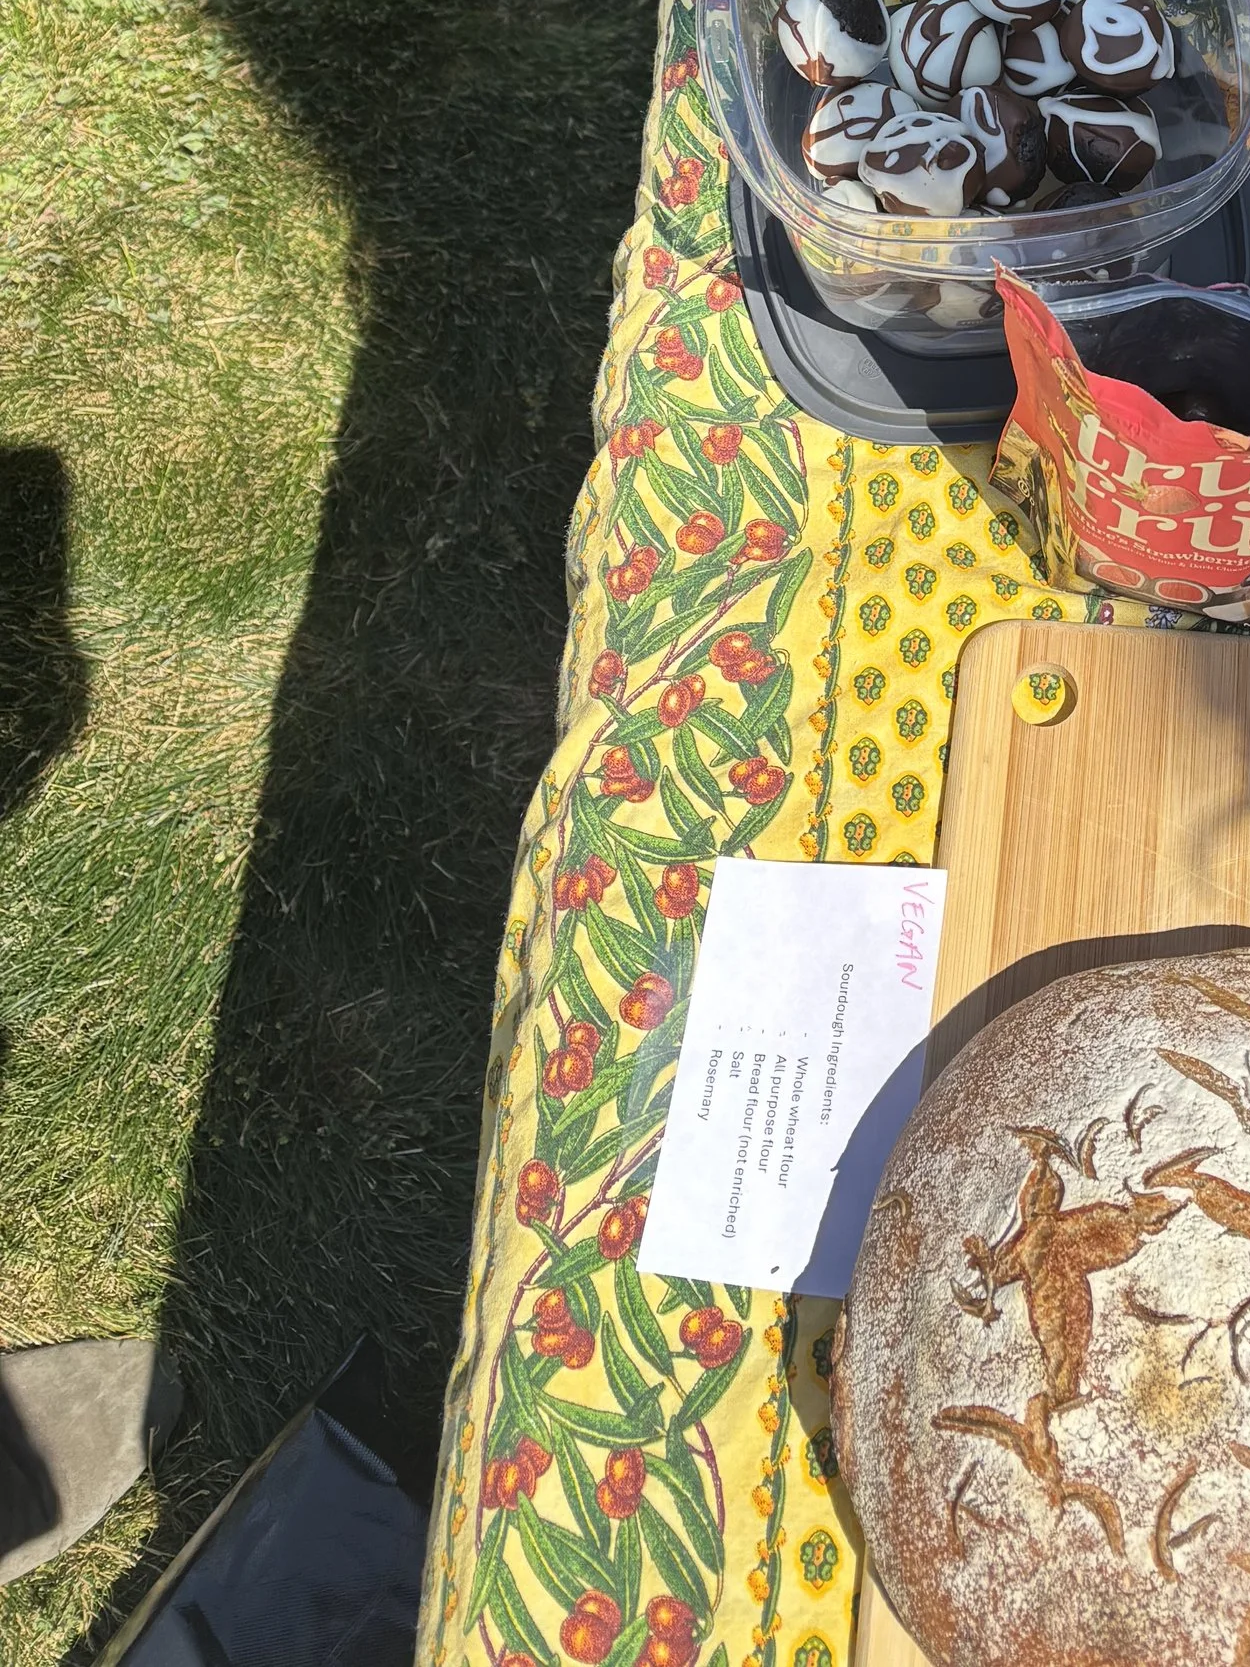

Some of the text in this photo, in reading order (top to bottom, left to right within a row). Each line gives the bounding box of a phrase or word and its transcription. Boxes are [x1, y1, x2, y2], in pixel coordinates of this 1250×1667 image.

[895, 881, 935, 991] VEGAN
[697, 1048, 723, 1121] Rosemary
[728, 1050, 745, 1079] Salt
[820, 963, 854, 1125] Sourdough Ingredients:
[721, 1053, 766, 1239] Bread flour (not enriched)
[758, 1054, 787, 1174] All purpose flour
[778, 1056, 809, 1188] Whole wheat flour
